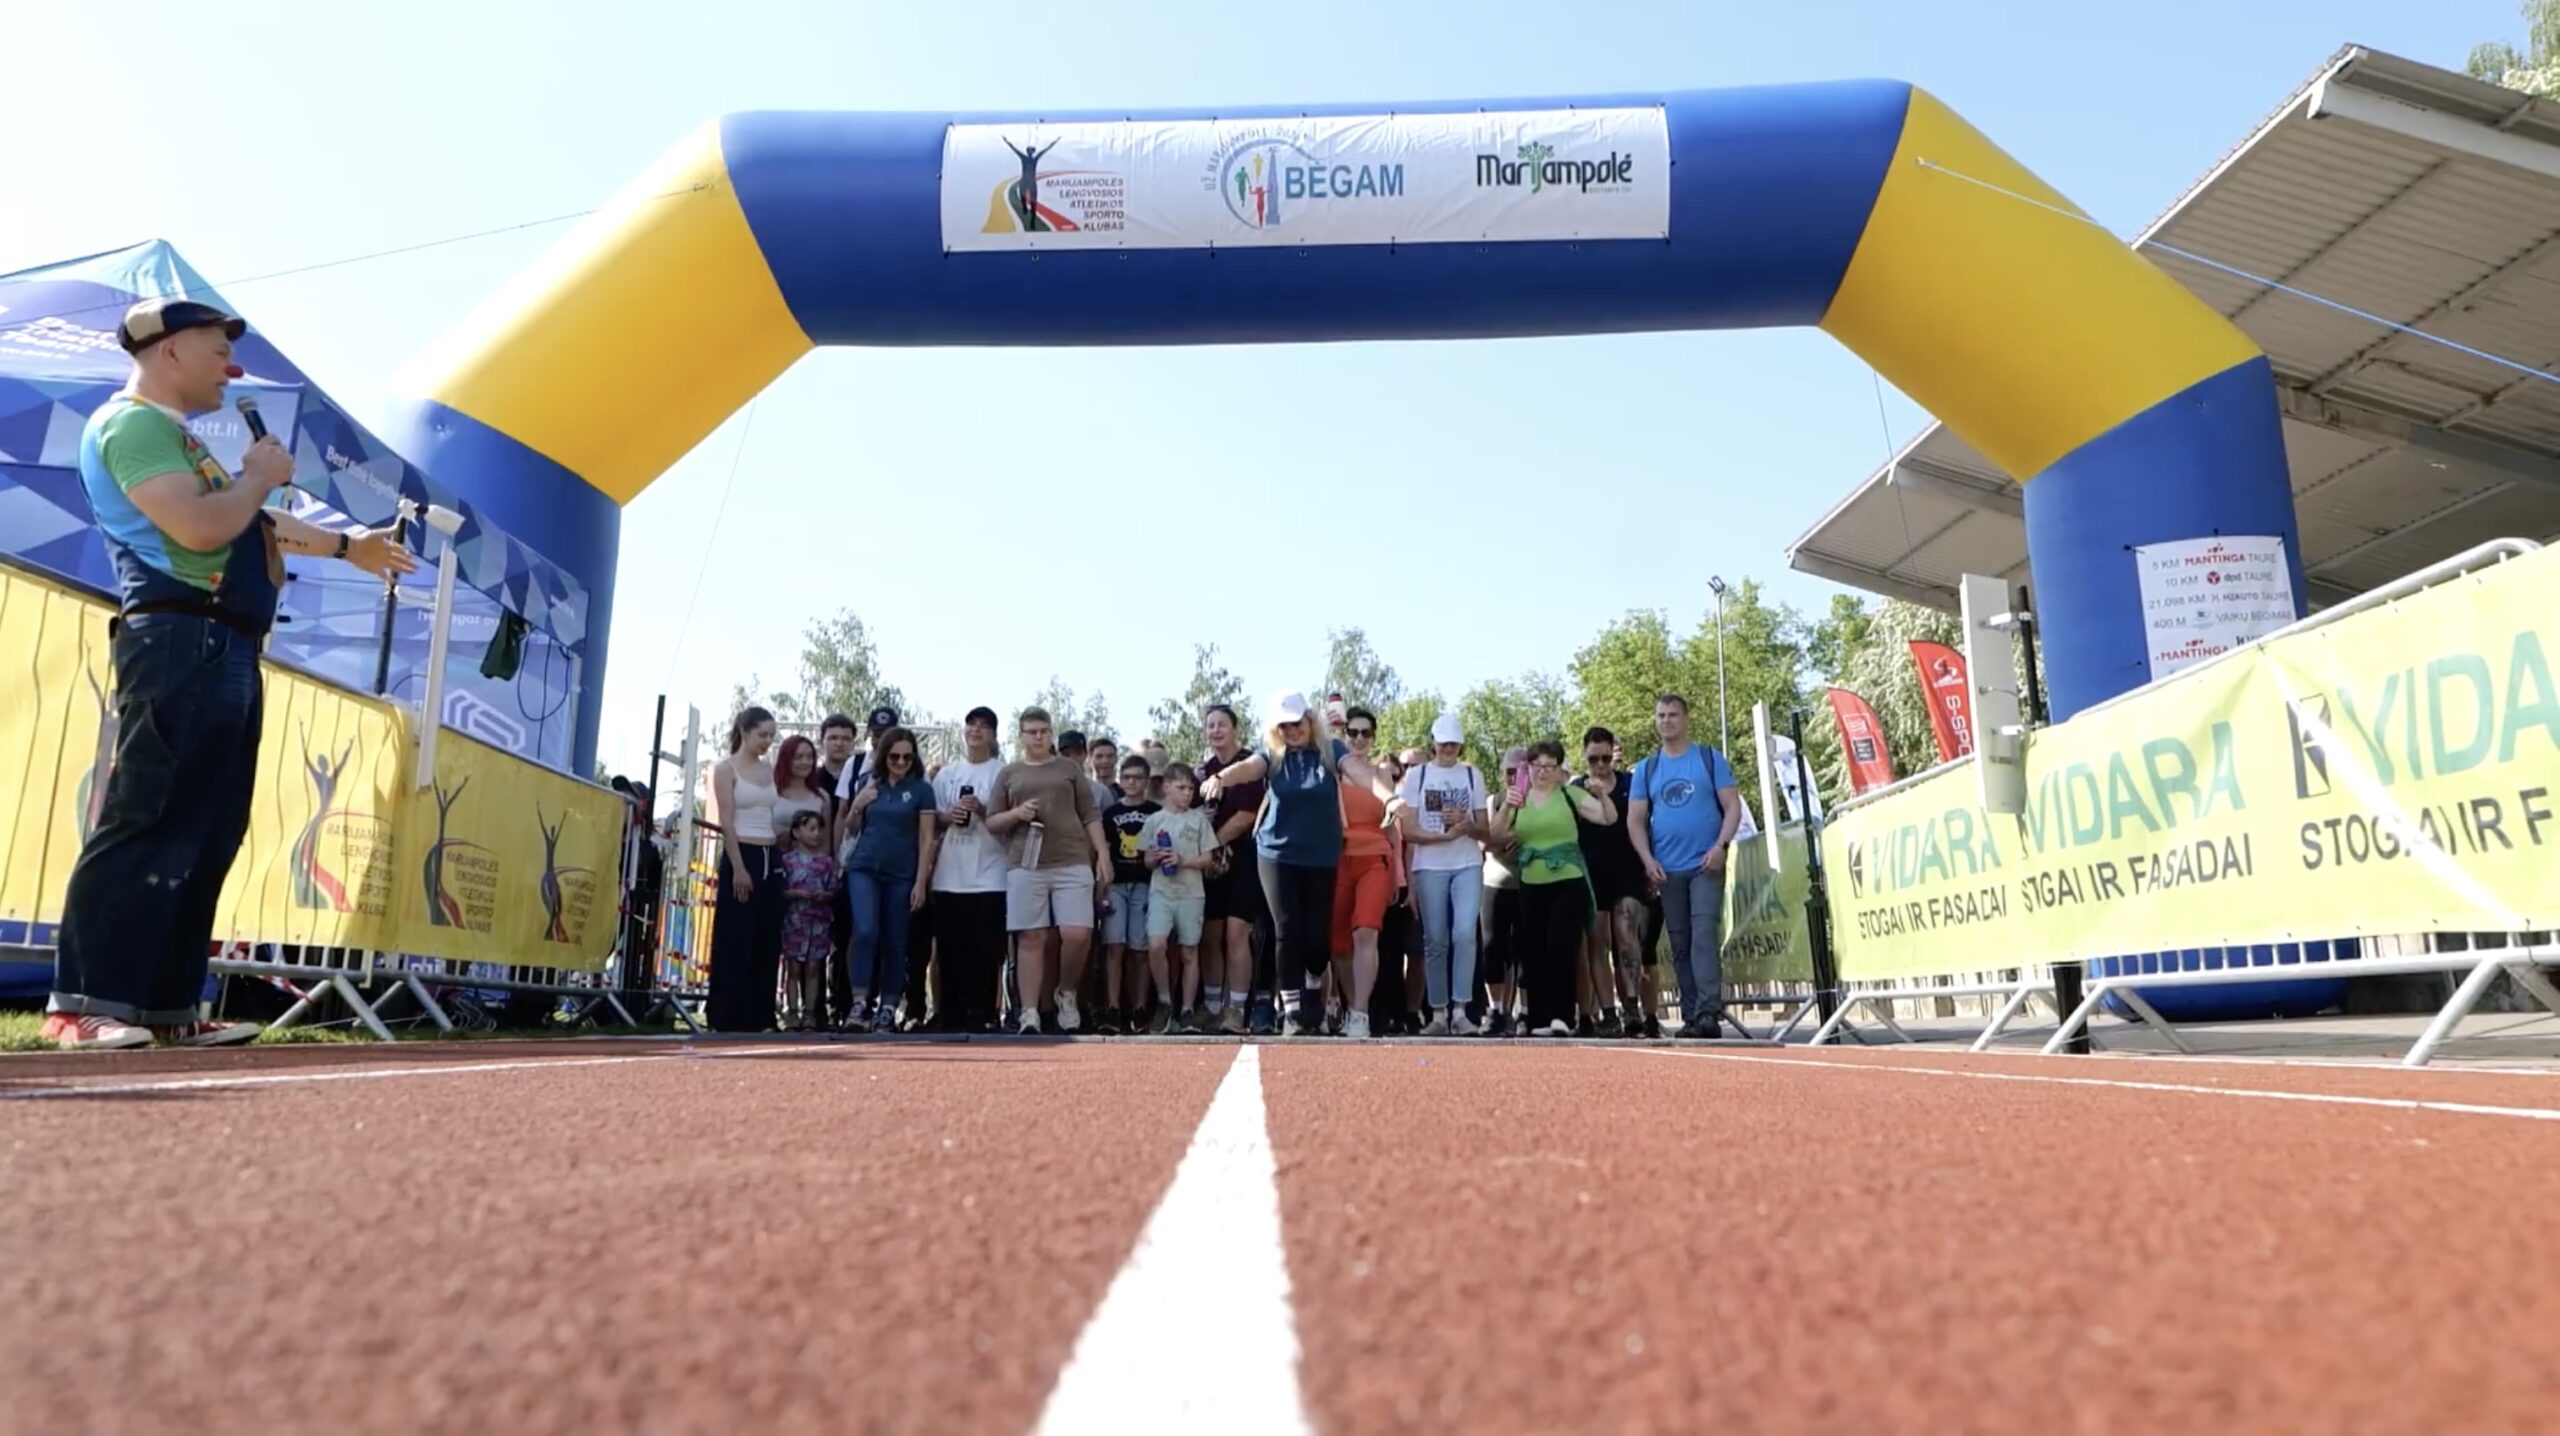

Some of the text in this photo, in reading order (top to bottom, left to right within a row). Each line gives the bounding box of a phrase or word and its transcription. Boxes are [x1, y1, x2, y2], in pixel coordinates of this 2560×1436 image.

[1285, 163, 1404, 199] BĖGAM
[1070, 200, 1124, 208] ATLETIKOS
[1083, 211, 1125, 220] SPORTO
[1083, 221, 1125, 231] KLUBAS
[2161, 557, 2180, 569] KM
[2184, 553, 2246, 567] MANTINGA
[2165, 577, 2178, 588] 10
[2180, 575, 2199, 586] KM
[2223, 571, 2242, 584] dpd
[2187, 593, 2206, 605] KM
[2176, 616, 2187, 627] M
[1873, 808, 2002, 894] VIDARA
[2087, 860, 2126, 902] IR
[2127, 832, 2254, 896] FASADAI
